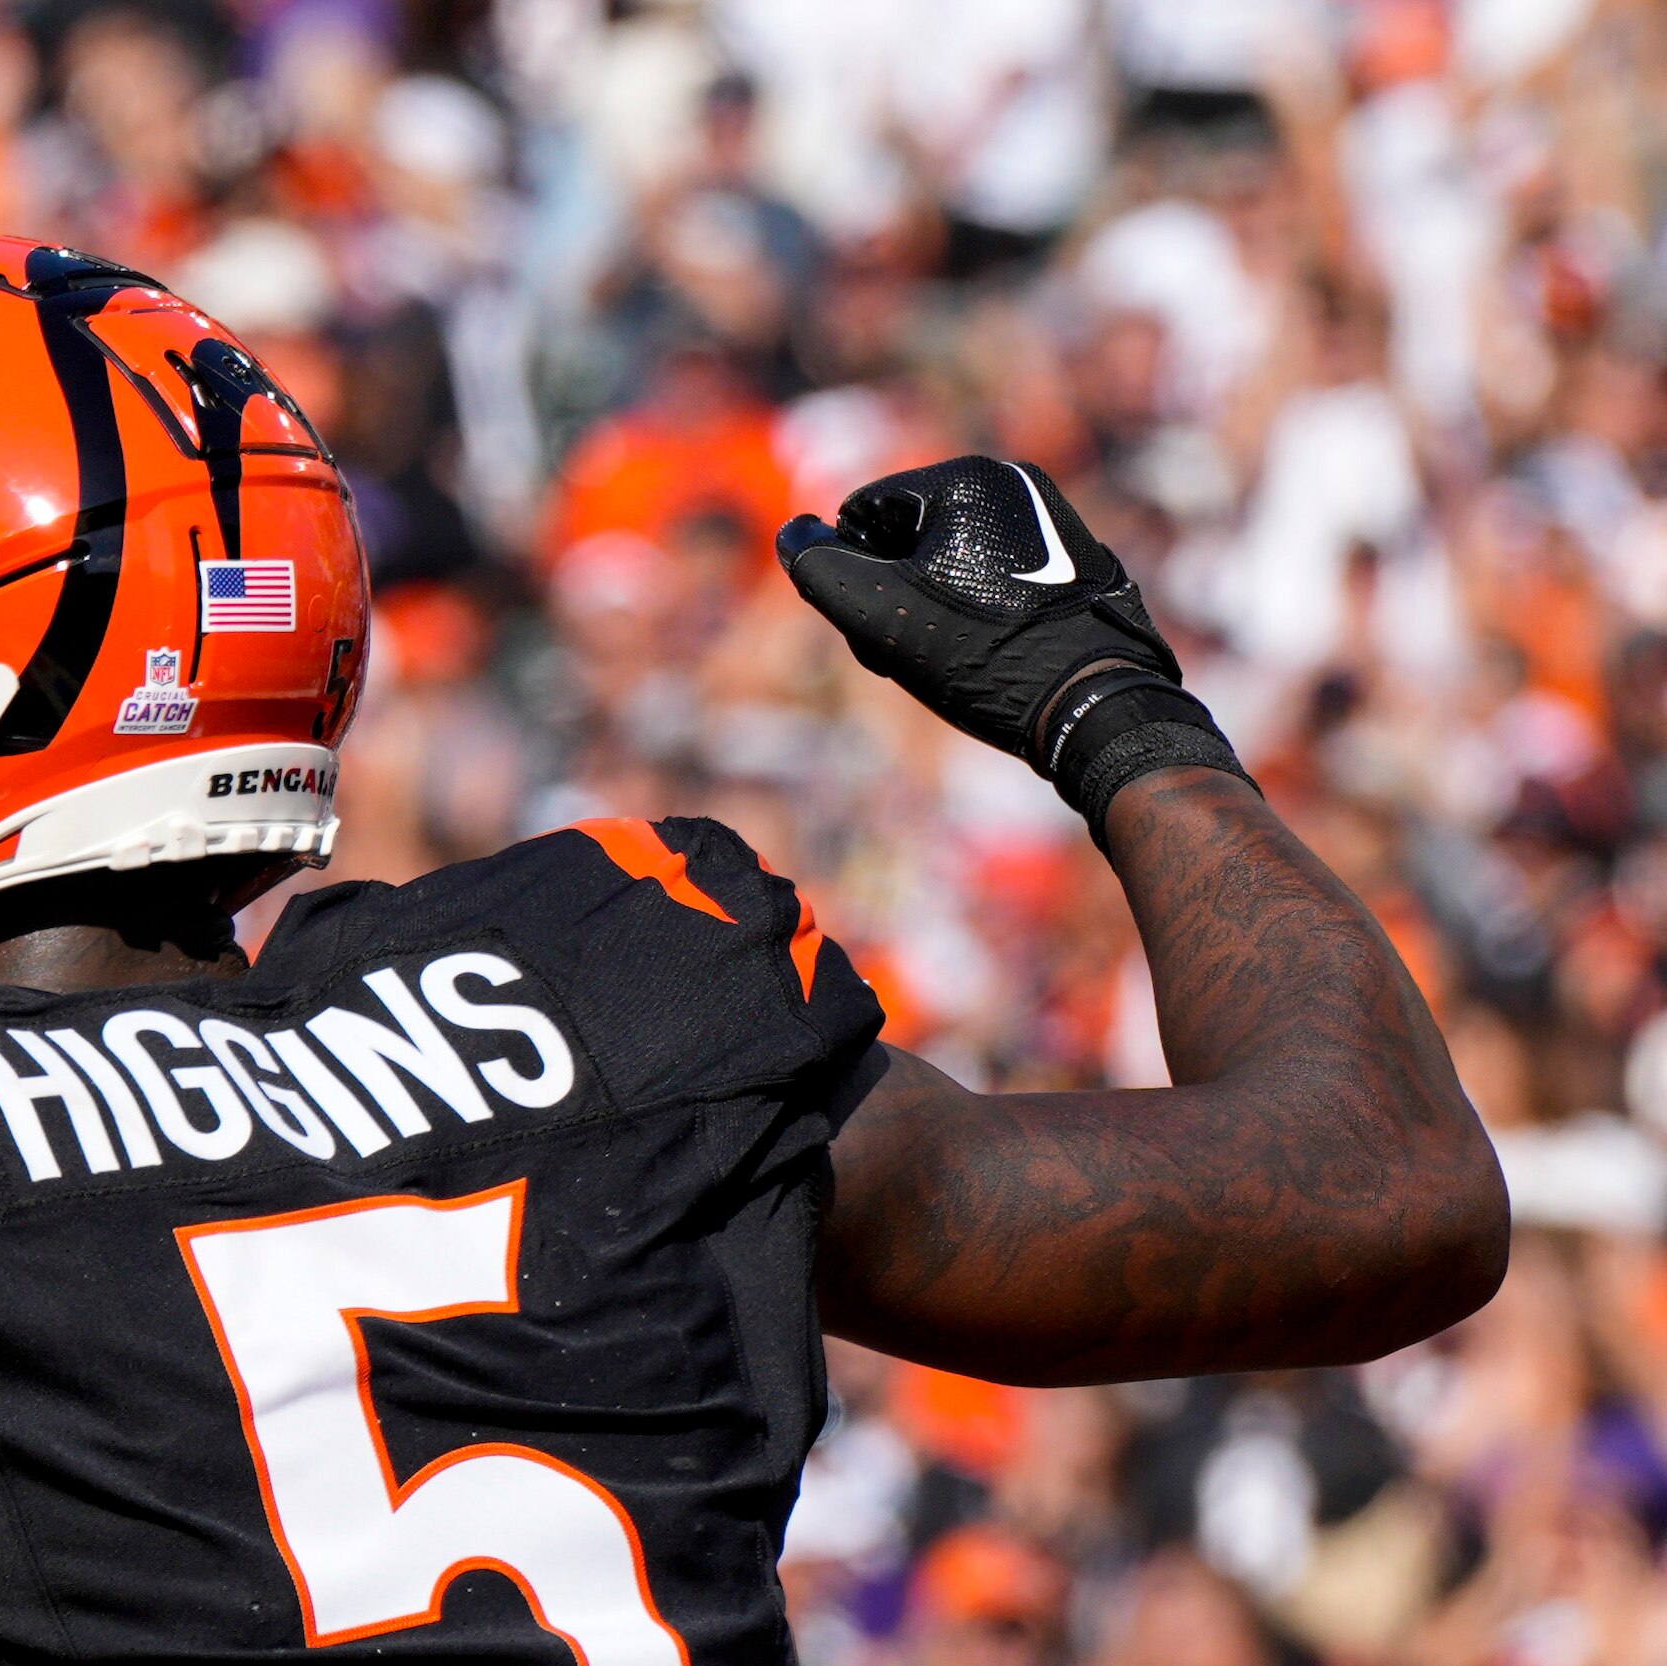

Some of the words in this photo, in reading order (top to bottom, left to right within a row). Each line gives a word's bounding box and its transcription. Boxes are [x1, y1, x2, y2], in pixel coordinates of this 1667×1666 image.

[152, 666, 174, 682] NFL
[136, 691, 186, 701] CRUCIAL
[311, 638, 354, 740] 5
[123, 702, 195, 722] CATCH
[1073, 704, 1090, 719] Do
